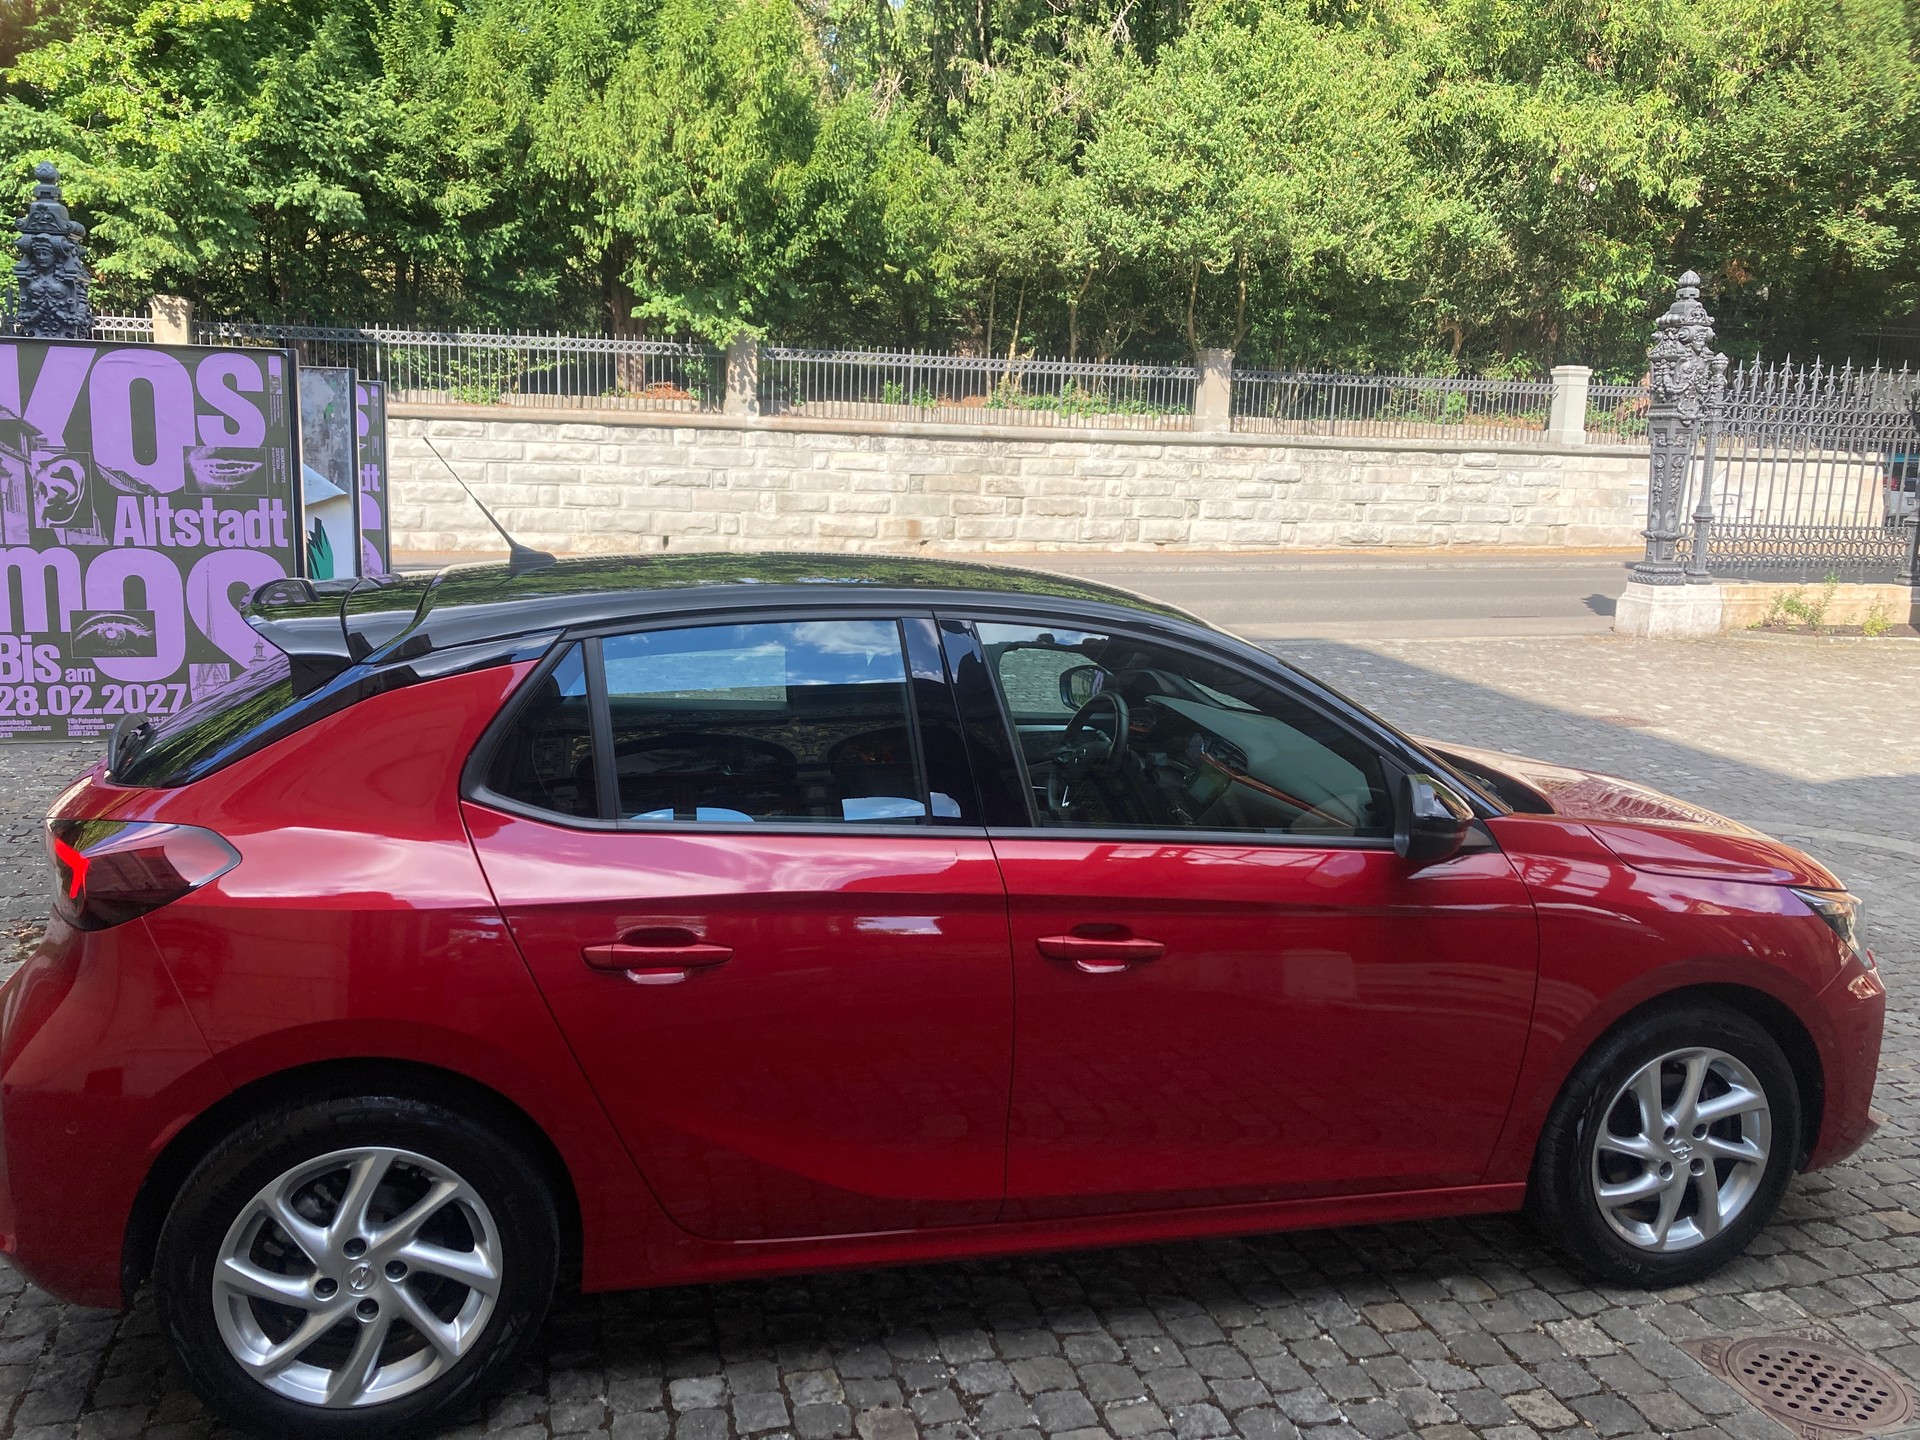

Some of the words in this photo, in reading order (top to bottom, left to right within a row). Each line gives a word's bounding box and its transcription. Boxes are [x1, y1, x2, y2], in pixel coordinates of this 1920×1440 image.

[113, 495, 288, 548] Altstadt
[0, 635, 62, 684] Bis
[65, 668, 96, 683] am
[0, 684, 187, 717] 28.02.2027
